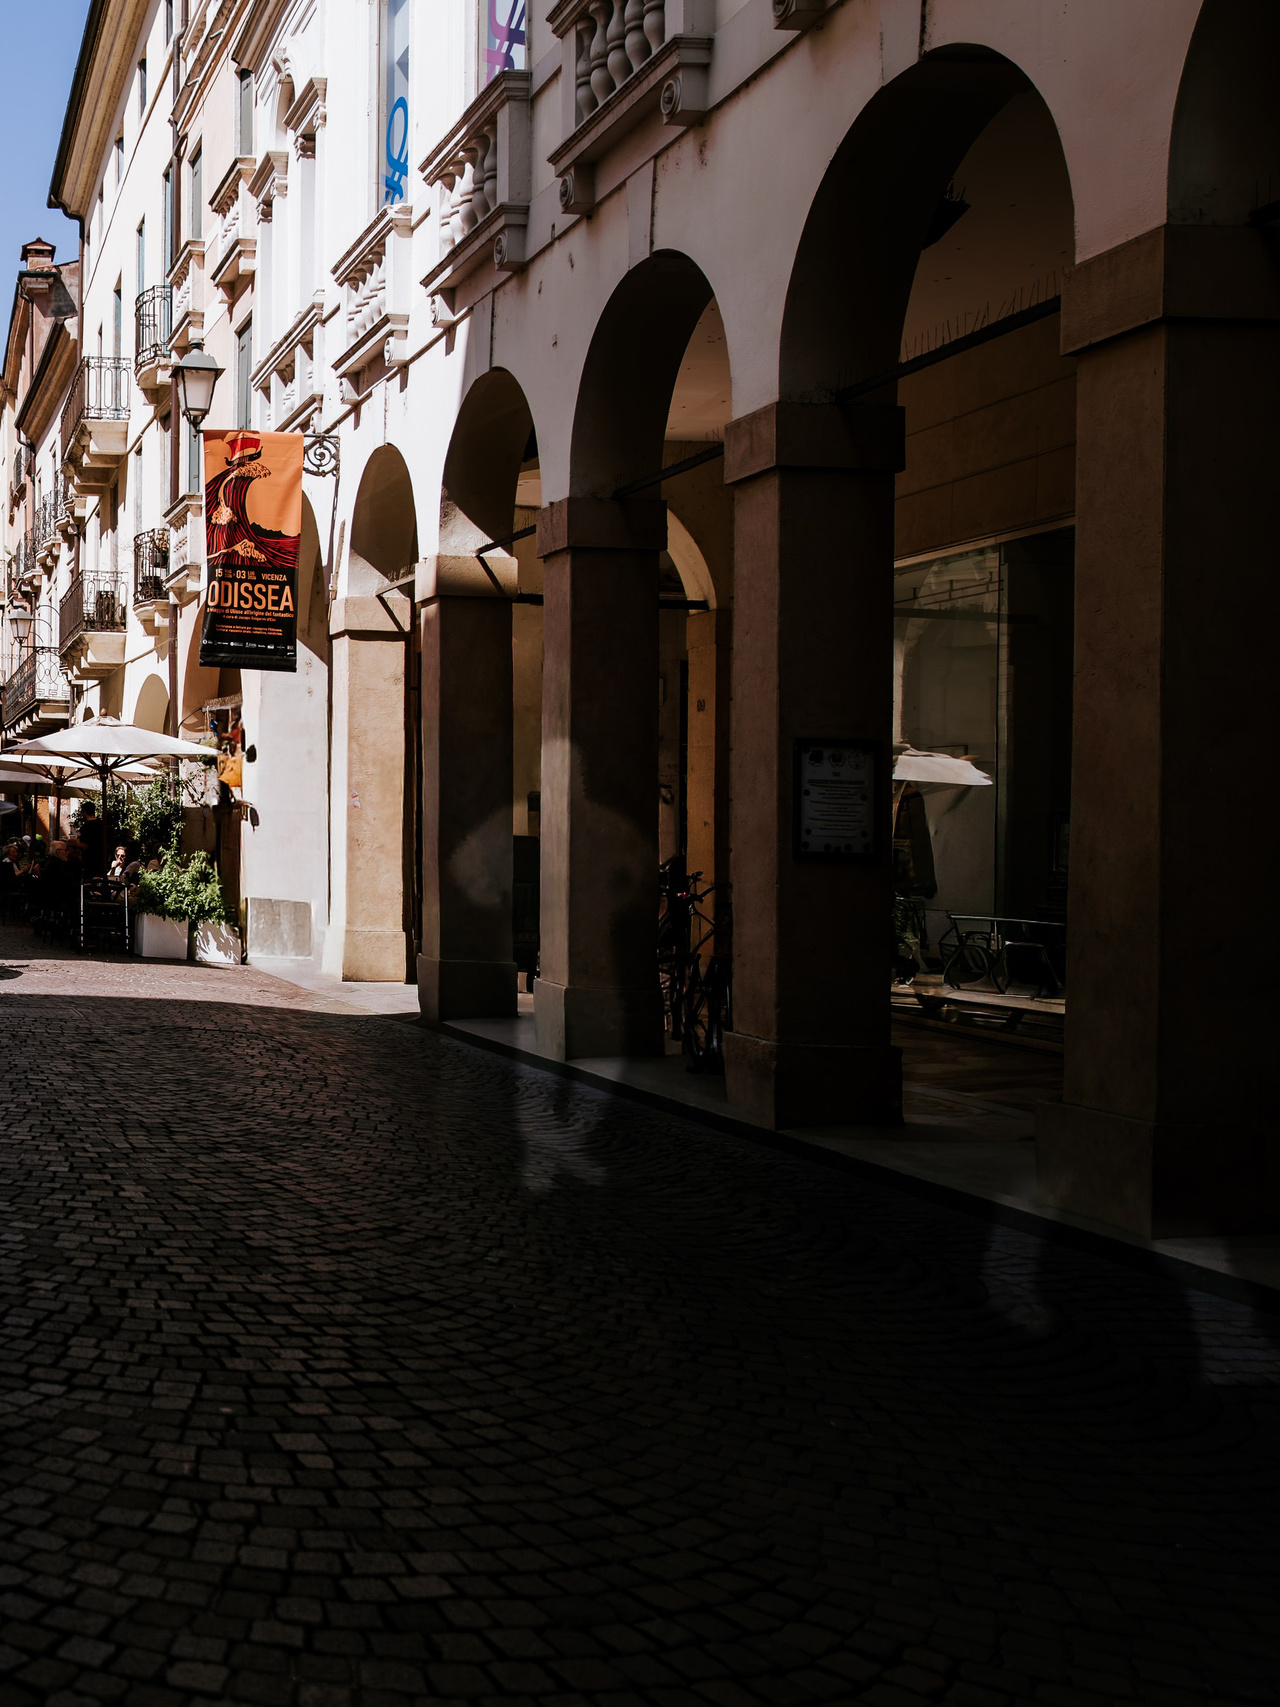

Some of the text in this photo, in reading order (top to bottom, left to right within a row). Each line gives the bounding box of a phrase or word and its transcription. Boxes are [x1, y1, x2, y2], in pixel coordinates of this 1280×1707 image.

[215, 568, 223, 578] 15
[236, 569, 246, 579] 03
[261, 573, 287, 581] VICENZA
[207, 580, 294, 611] ODISSEA
